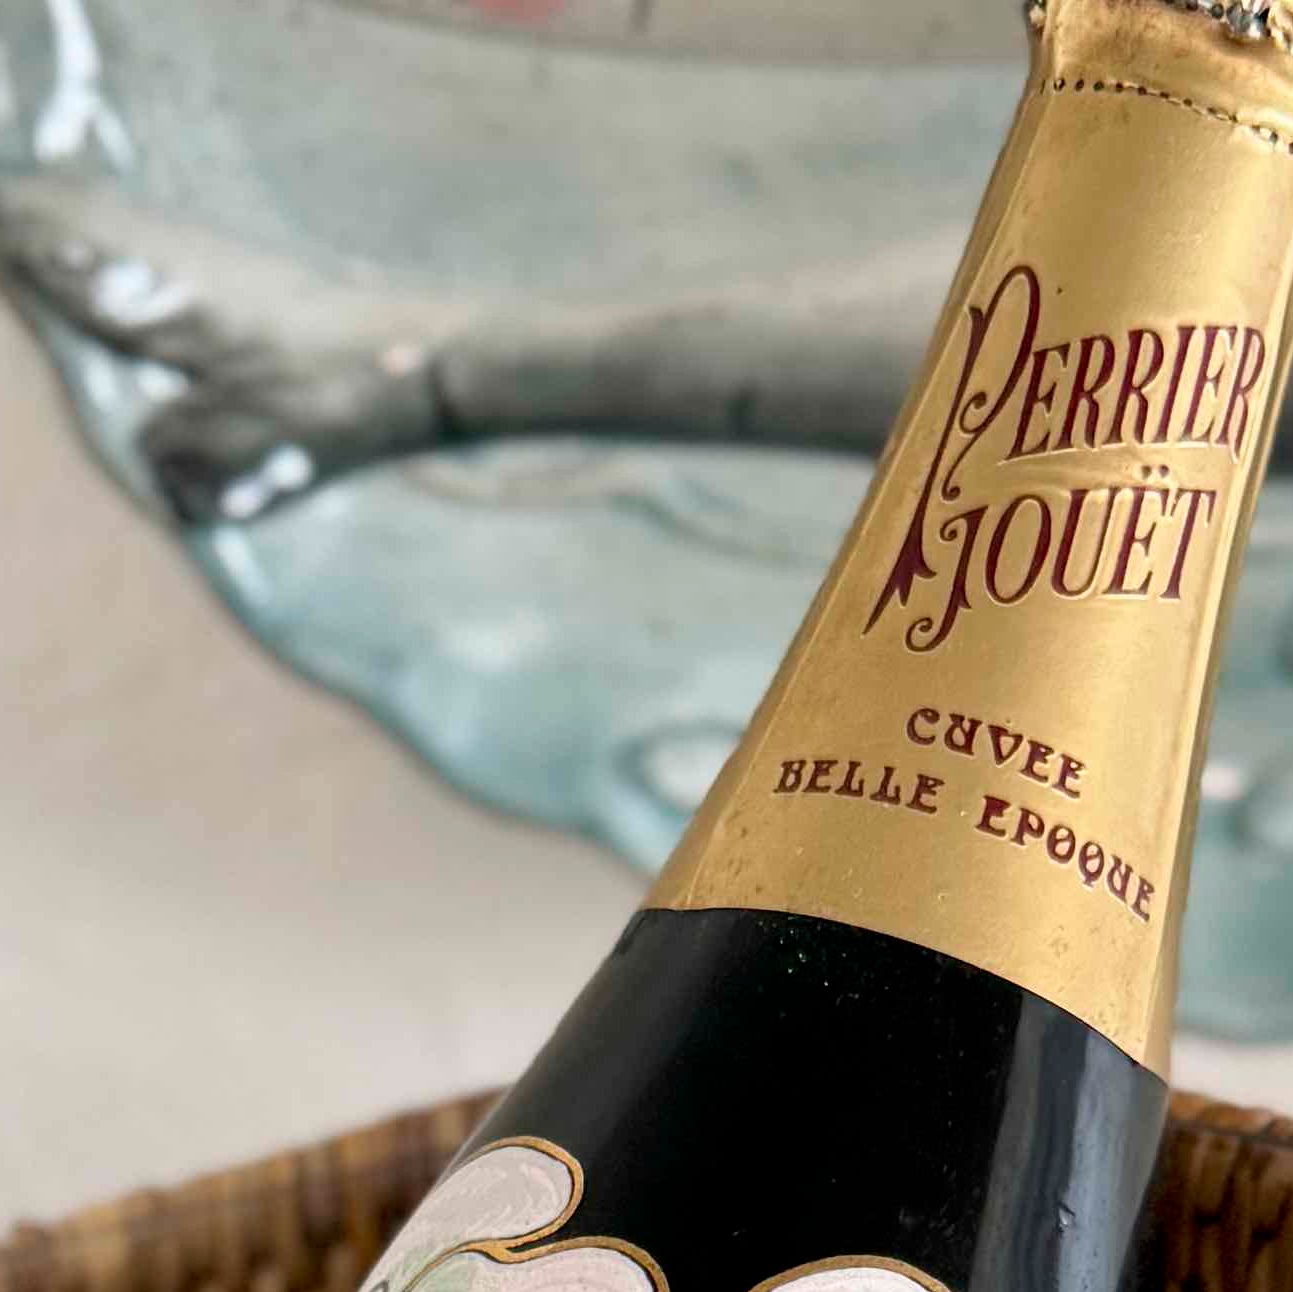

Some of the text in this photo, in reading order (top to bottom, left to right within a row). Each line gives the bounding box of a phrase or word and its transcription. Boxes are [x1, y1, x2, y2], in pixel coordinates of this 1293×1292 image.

[862, 264, 1267, 634] PERRIER
[905, 463, 1217, 653] JOUËT
[774, 758, 1157, 922] BELLE EPOQUE
[905, 706, 1087, 798] CUVEE
